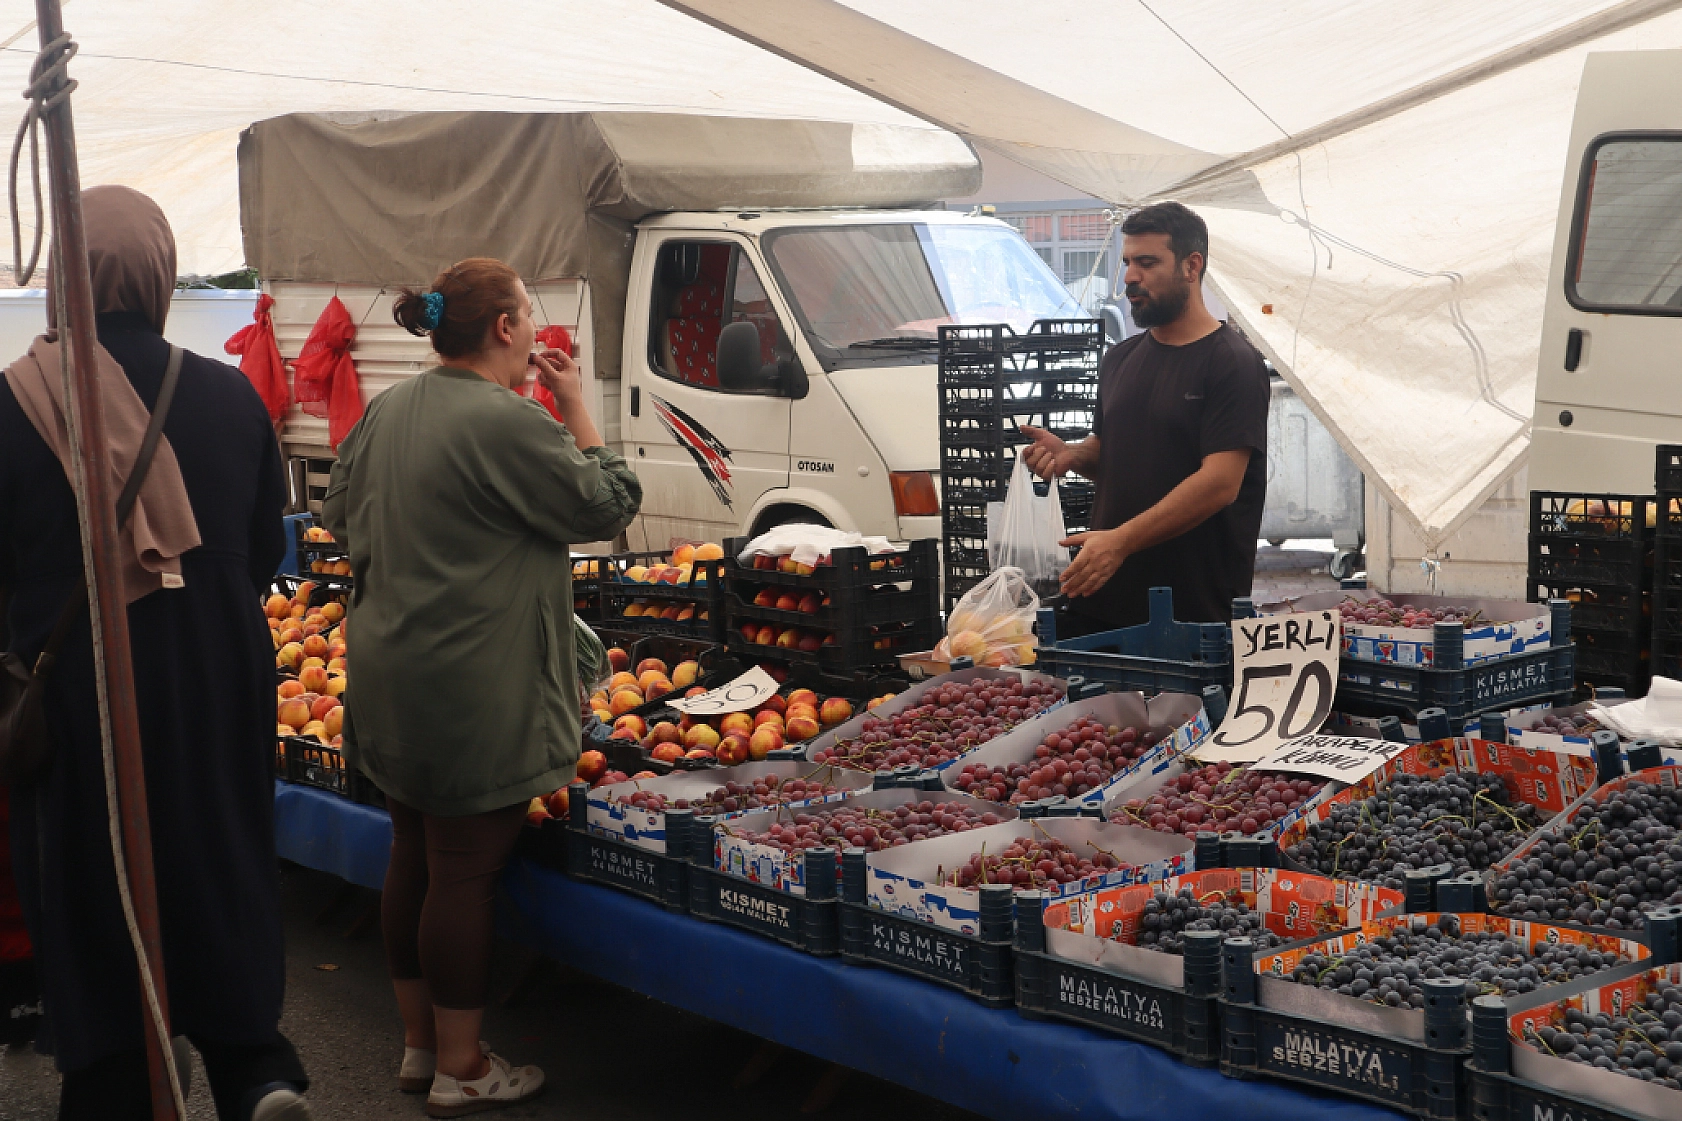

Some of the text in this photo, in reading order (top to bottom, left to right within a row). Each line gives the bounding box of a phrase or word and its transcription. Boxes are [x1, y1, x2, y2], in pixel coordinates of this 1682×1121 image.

[797, 460, 835, 473] OTOSAN
[1477, 661, 1549, 689] KISMET
[1493, 674, 1547, 696] MALATYA
[1213, 660, 1333, 747] 50
[591, 846, 656, 875] KISMET
[607, 862, 656, 885] MALATYA
[720, 887, 791, 919] KISMET
[746, 907, 790, 928] MALATYA
[872, 923, 964, 960] KISMET
[874, 938, 964, 973] 44 MALATYA
[1060, 974, 1163, 1017] MALATYA
[1134, 1010, 1165, 1030] 2024
[1272, 1046, 1341, 1075] SEBZE
[1284, 1032, 1383, 1072] MALATYA
